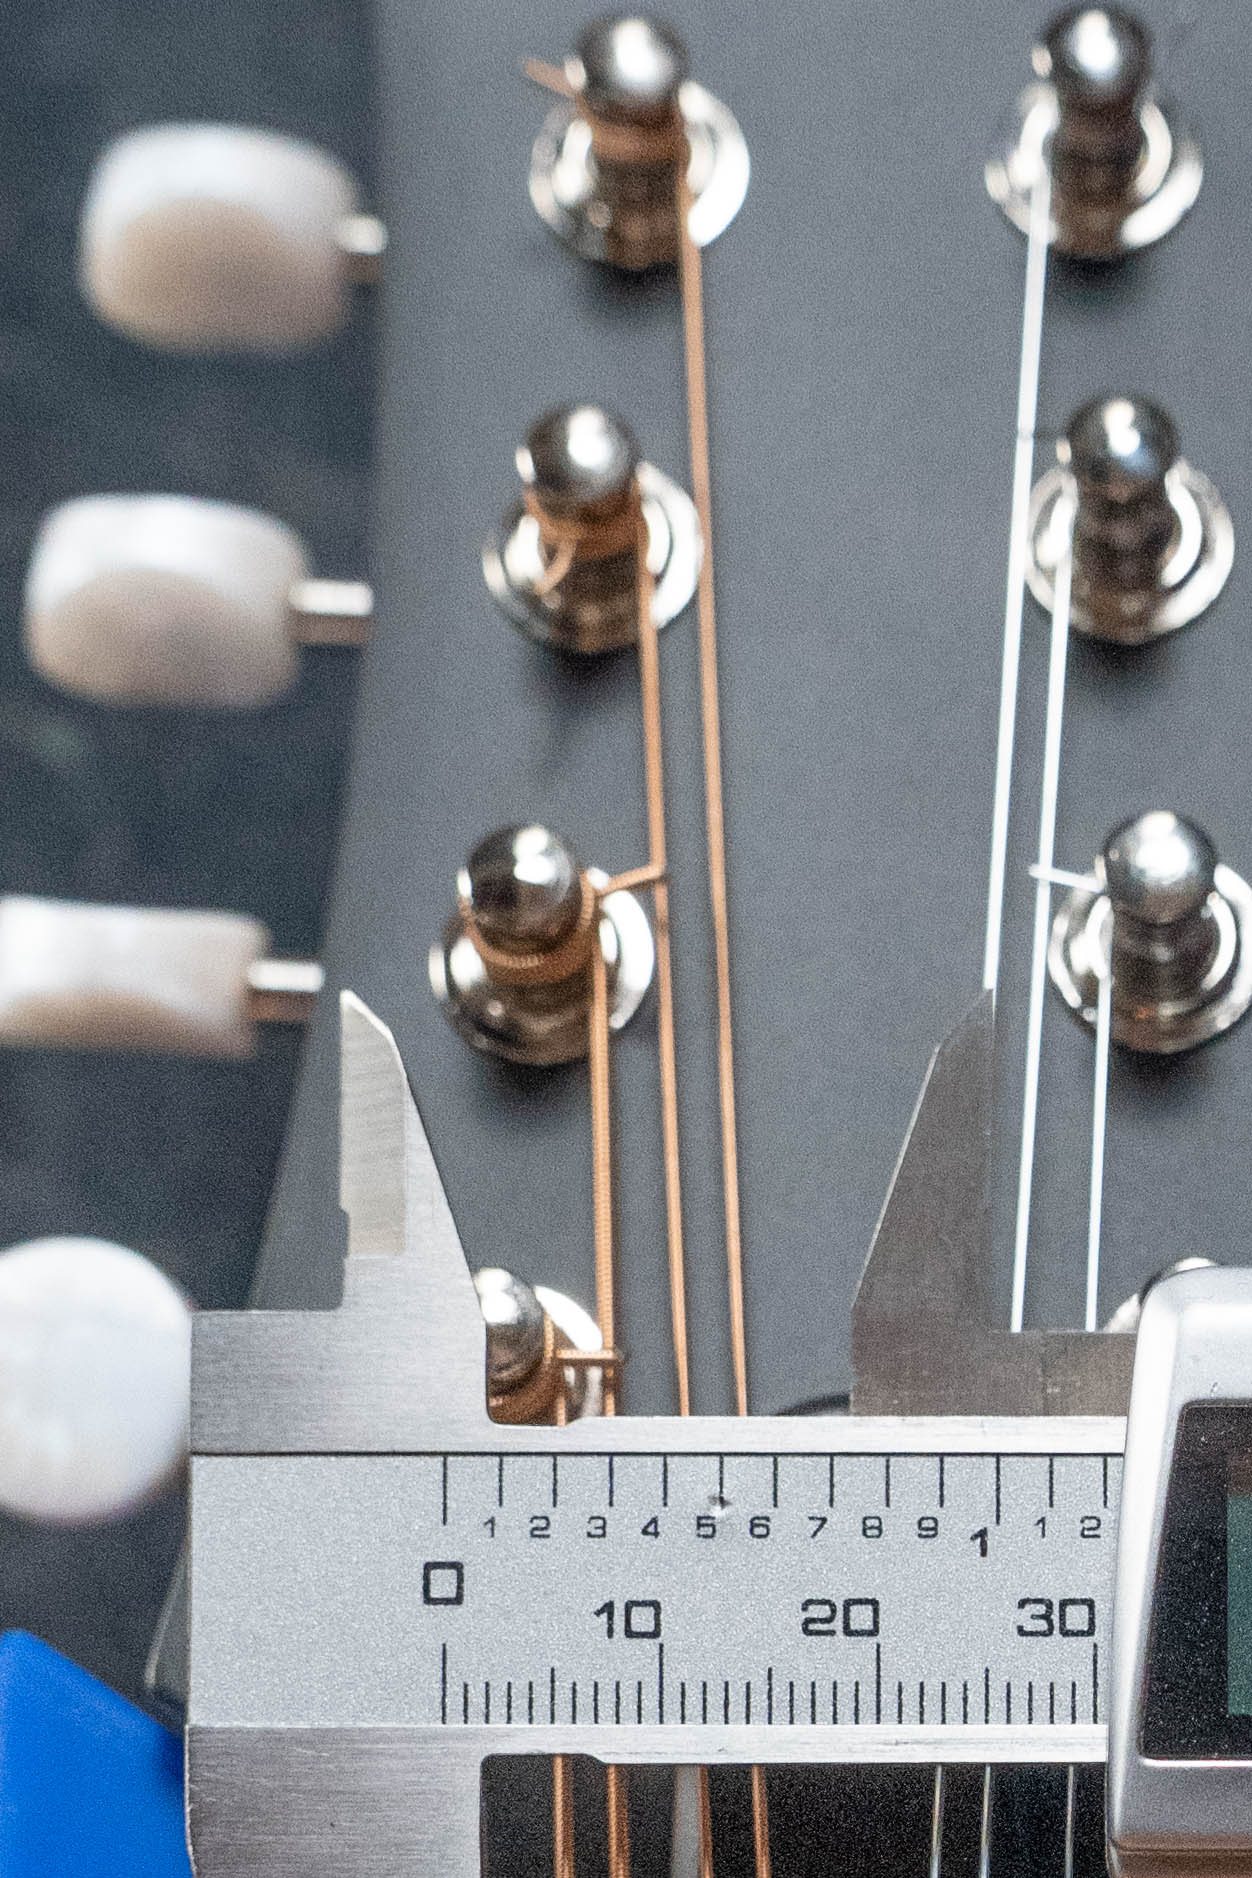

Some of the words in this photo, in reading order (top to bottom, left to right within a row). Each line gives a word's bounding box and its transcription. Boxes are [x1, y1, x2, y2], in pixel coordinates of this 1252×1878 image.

[484, 1516, 496, 1539] 1
[530, 1516, 551, 1539] 2
[586, 1516, 608, 1539] 3
[641, 1516, 661, 1539] 4
[696, 1515, 717, 1539] 5
[749, 1516, 770, 1539] 6
[808, 1516, 828, 1539] 7
[862, 1516, 884, 1539] 8
[917, 1516, 939, 1539] 9
[970, 1527, 988, 1558] 1
[1035, 1516, 1047, 1539] 1
[1080, 1516, 1102, 1539] 2
[422, 1560, 465, 1606] 0
[593, 1599, 662, 1639] 10
[801, 1598, 880, 1637] 20
[1016, 1597, 1097, 1637] 30
